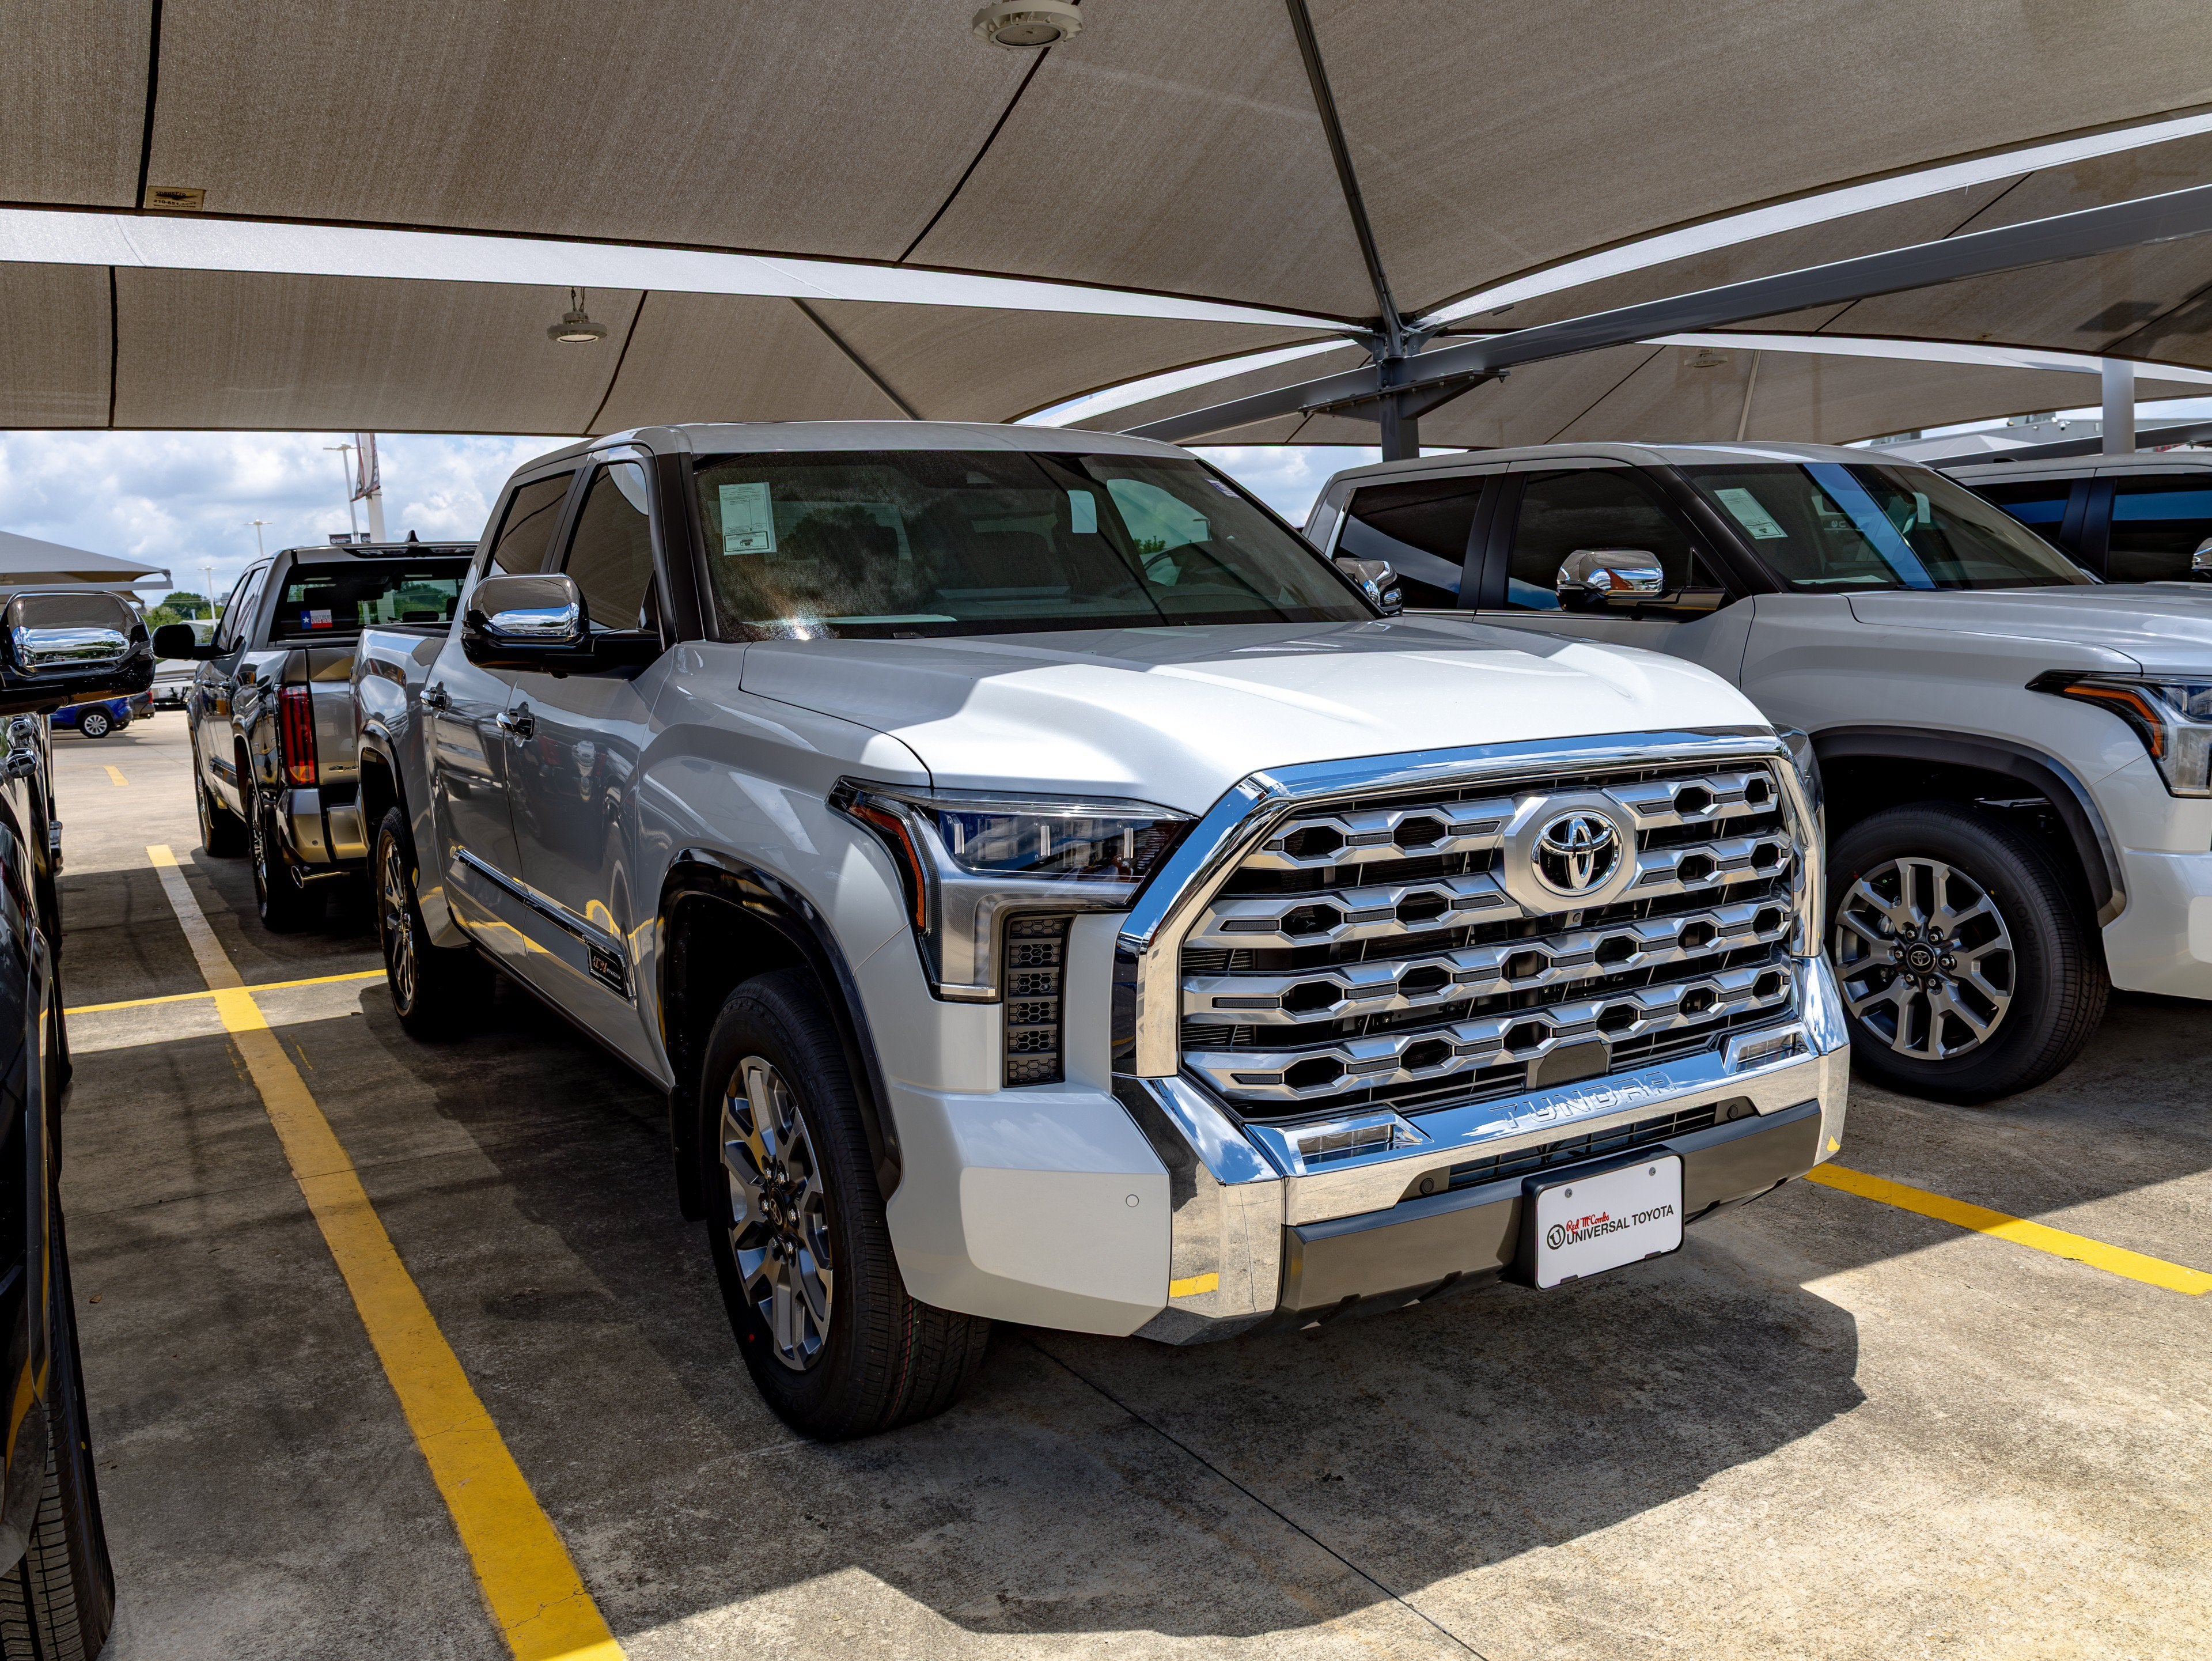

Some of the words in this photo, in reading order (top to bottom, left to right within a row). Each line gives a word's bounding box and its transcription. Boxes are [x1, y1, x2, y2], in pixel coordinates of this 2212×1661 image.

[1488, 1071, 1678, 1129] TUNDRA
[1566, 1217, 1630, 1245] UNIVERSAL
[1631, 1204, 1674, 1226] TOYOTA
[1566, 1219, 1580, 1233] Red
